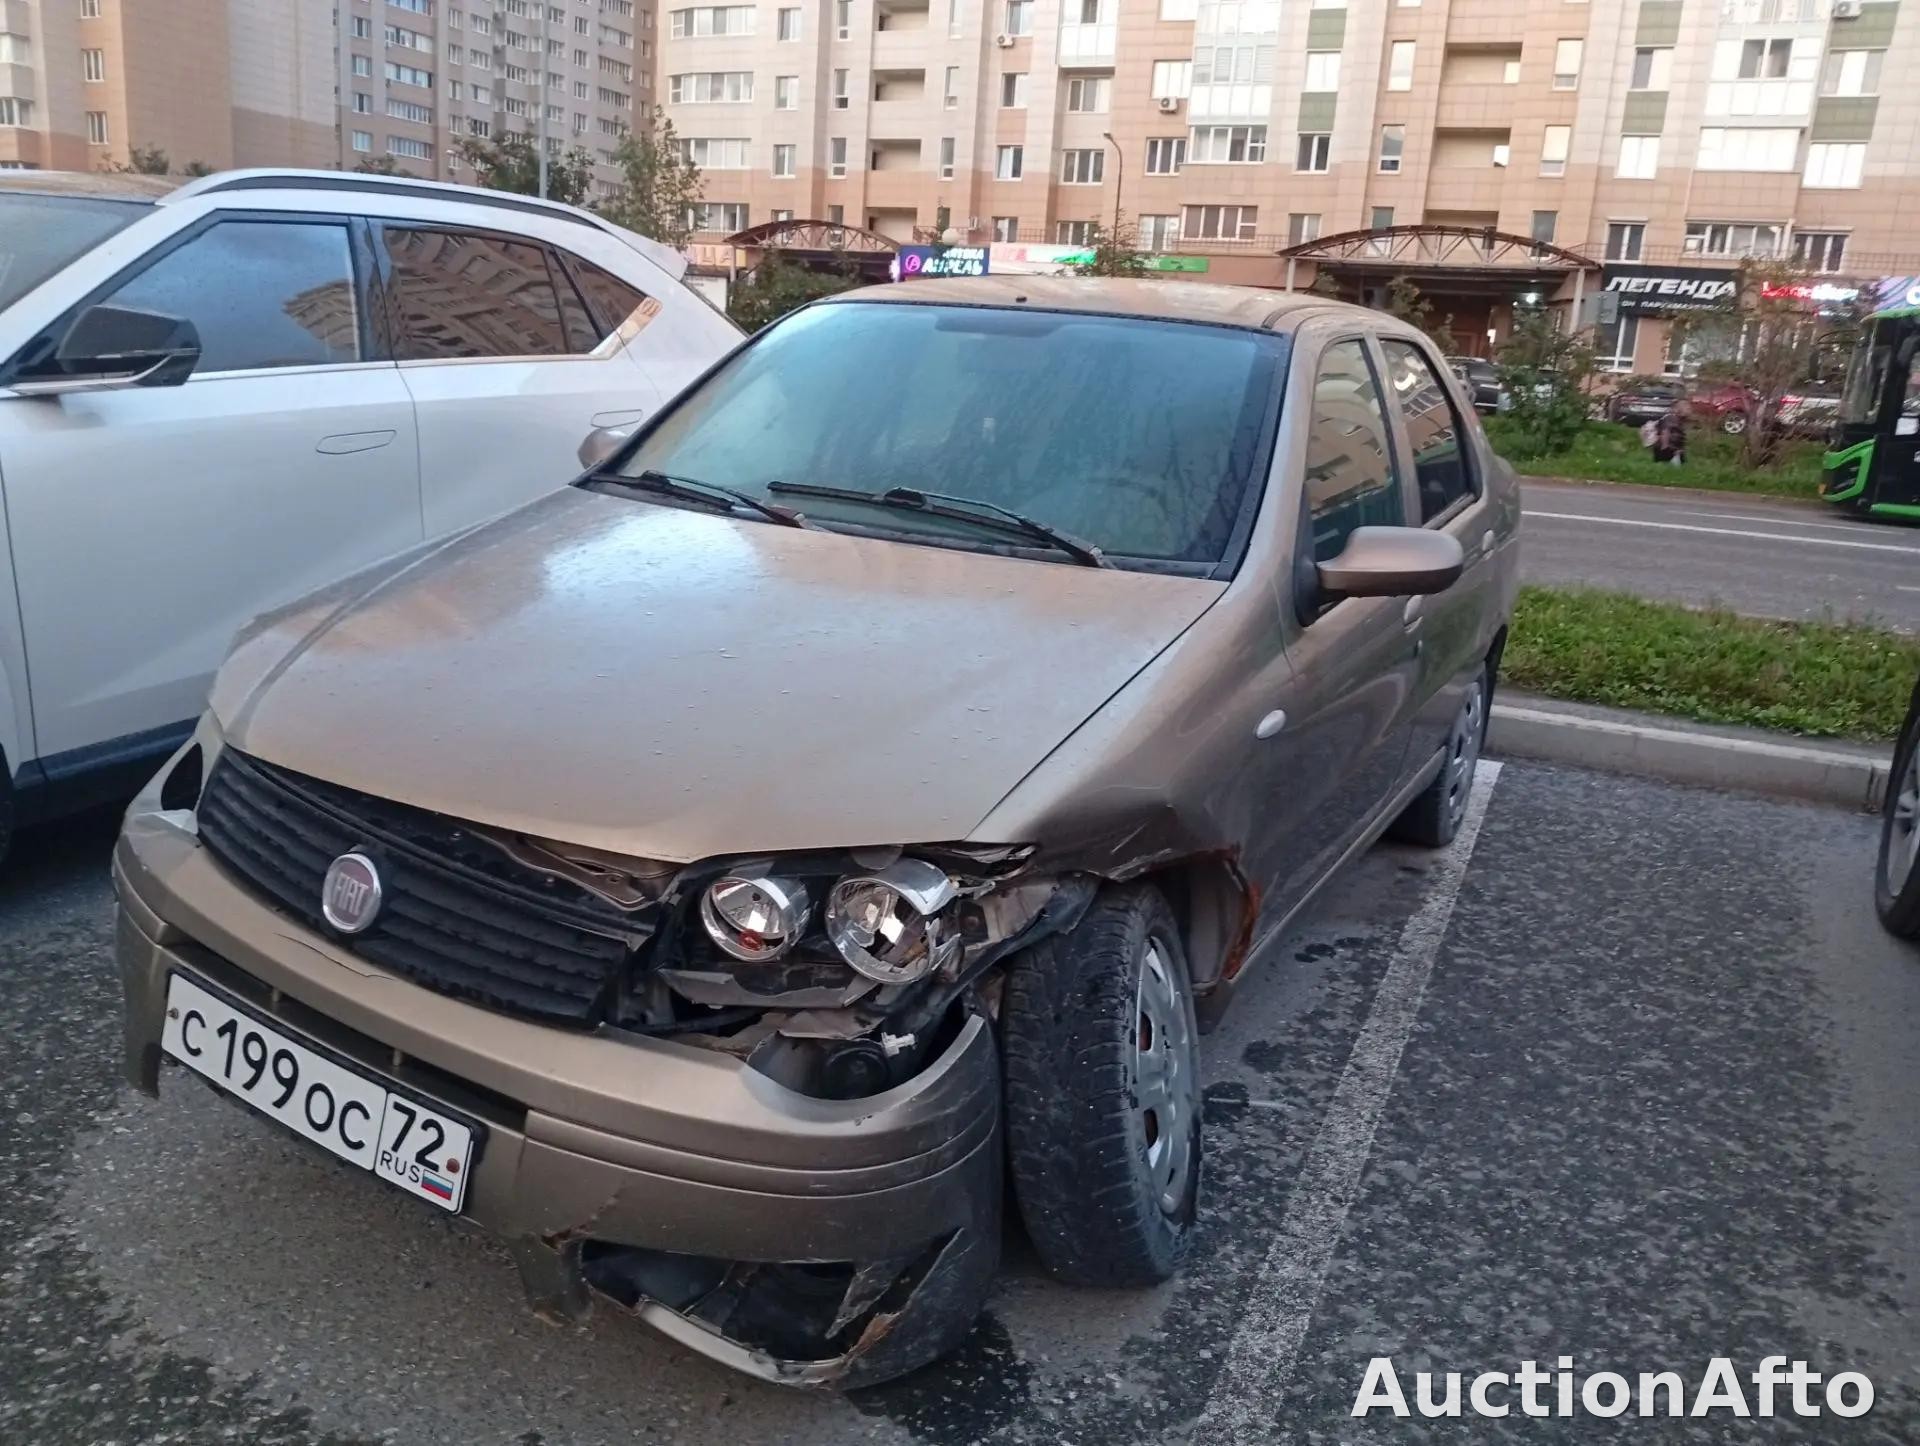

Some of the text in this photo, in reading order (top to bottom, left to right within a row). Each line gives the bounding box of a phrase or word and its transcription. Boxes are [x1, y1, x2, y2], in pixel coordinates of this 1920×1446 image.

[1605, 276, 1737, 300] ЛЕГЕНДА
[331, 871, 369, 917] FIAT
[392, 1101, 446, 1173] 72
[379, 1151, 420, 1184] RUS
